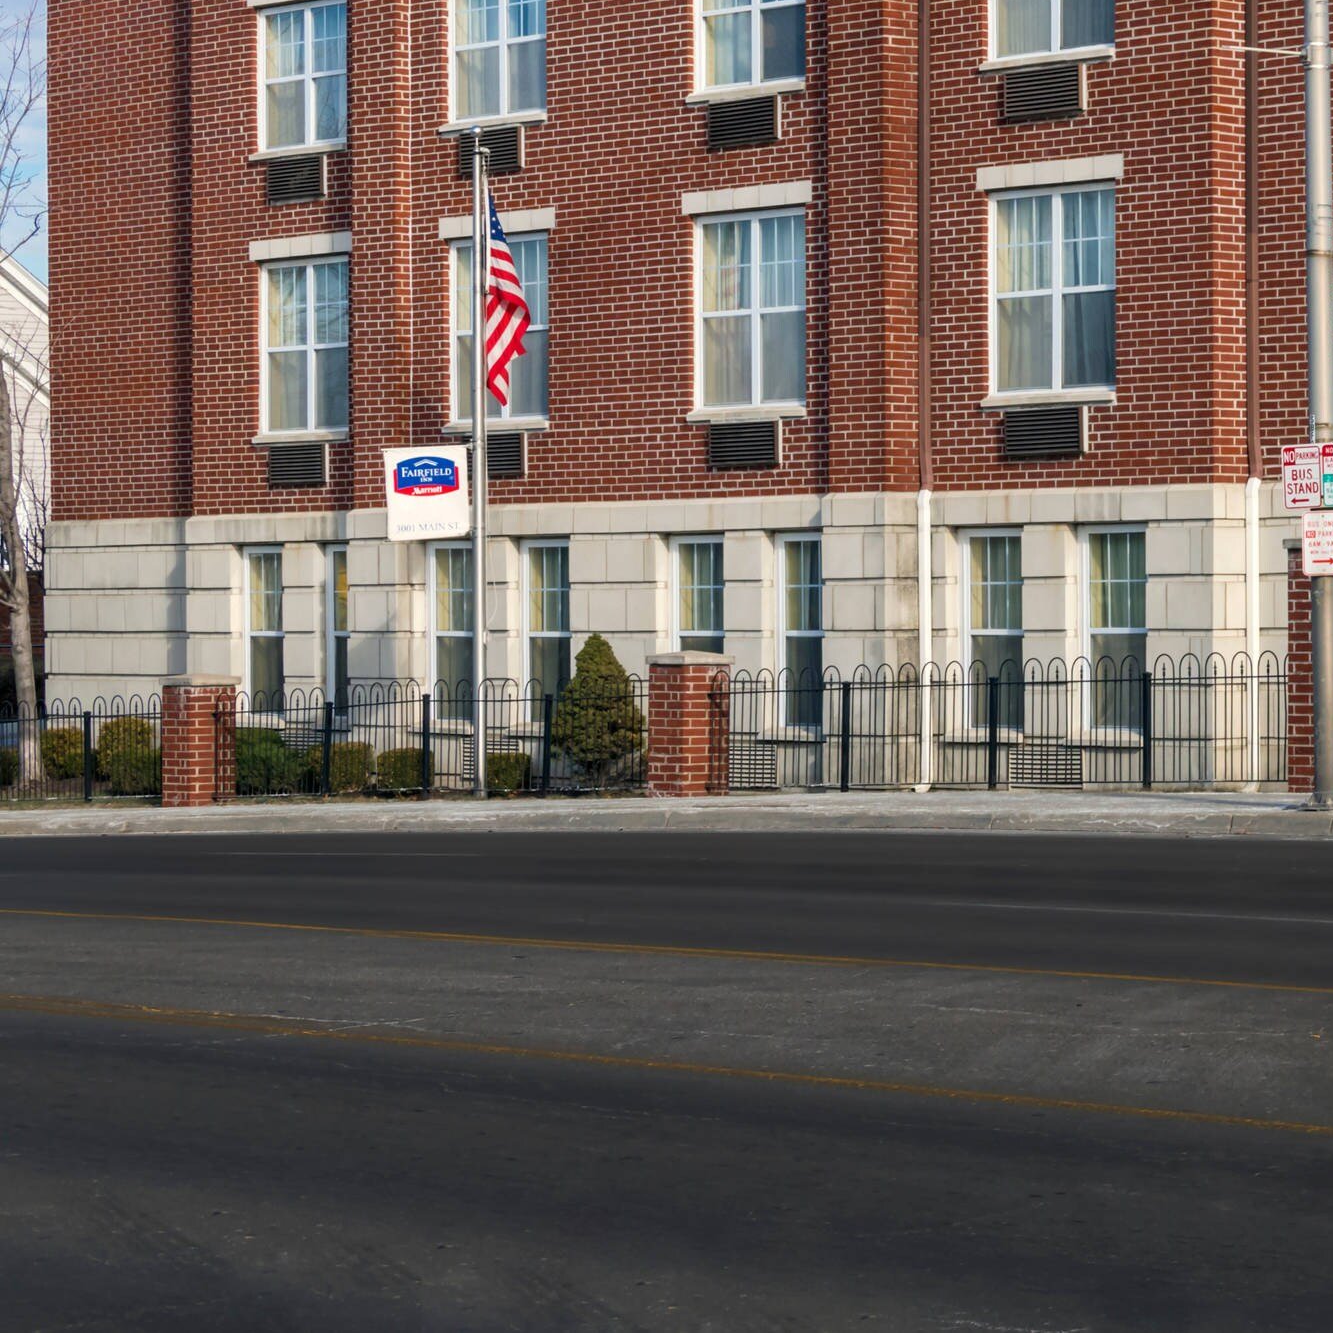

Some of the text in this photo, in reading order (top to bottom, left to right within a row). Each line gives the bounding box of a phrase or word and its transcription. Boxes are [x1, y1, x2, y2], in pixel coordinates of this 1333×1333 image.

[1283, 451, 1319, 463] NO PARKING
[401, 467, 452, 478] FAIRFIELD
[1291, 468, 1313, 481] BUS
[411, 486, 443, 495] Marriott
[1287, 482, 1319, 495] STAND
[418, 522, 445, 531] MAIN
